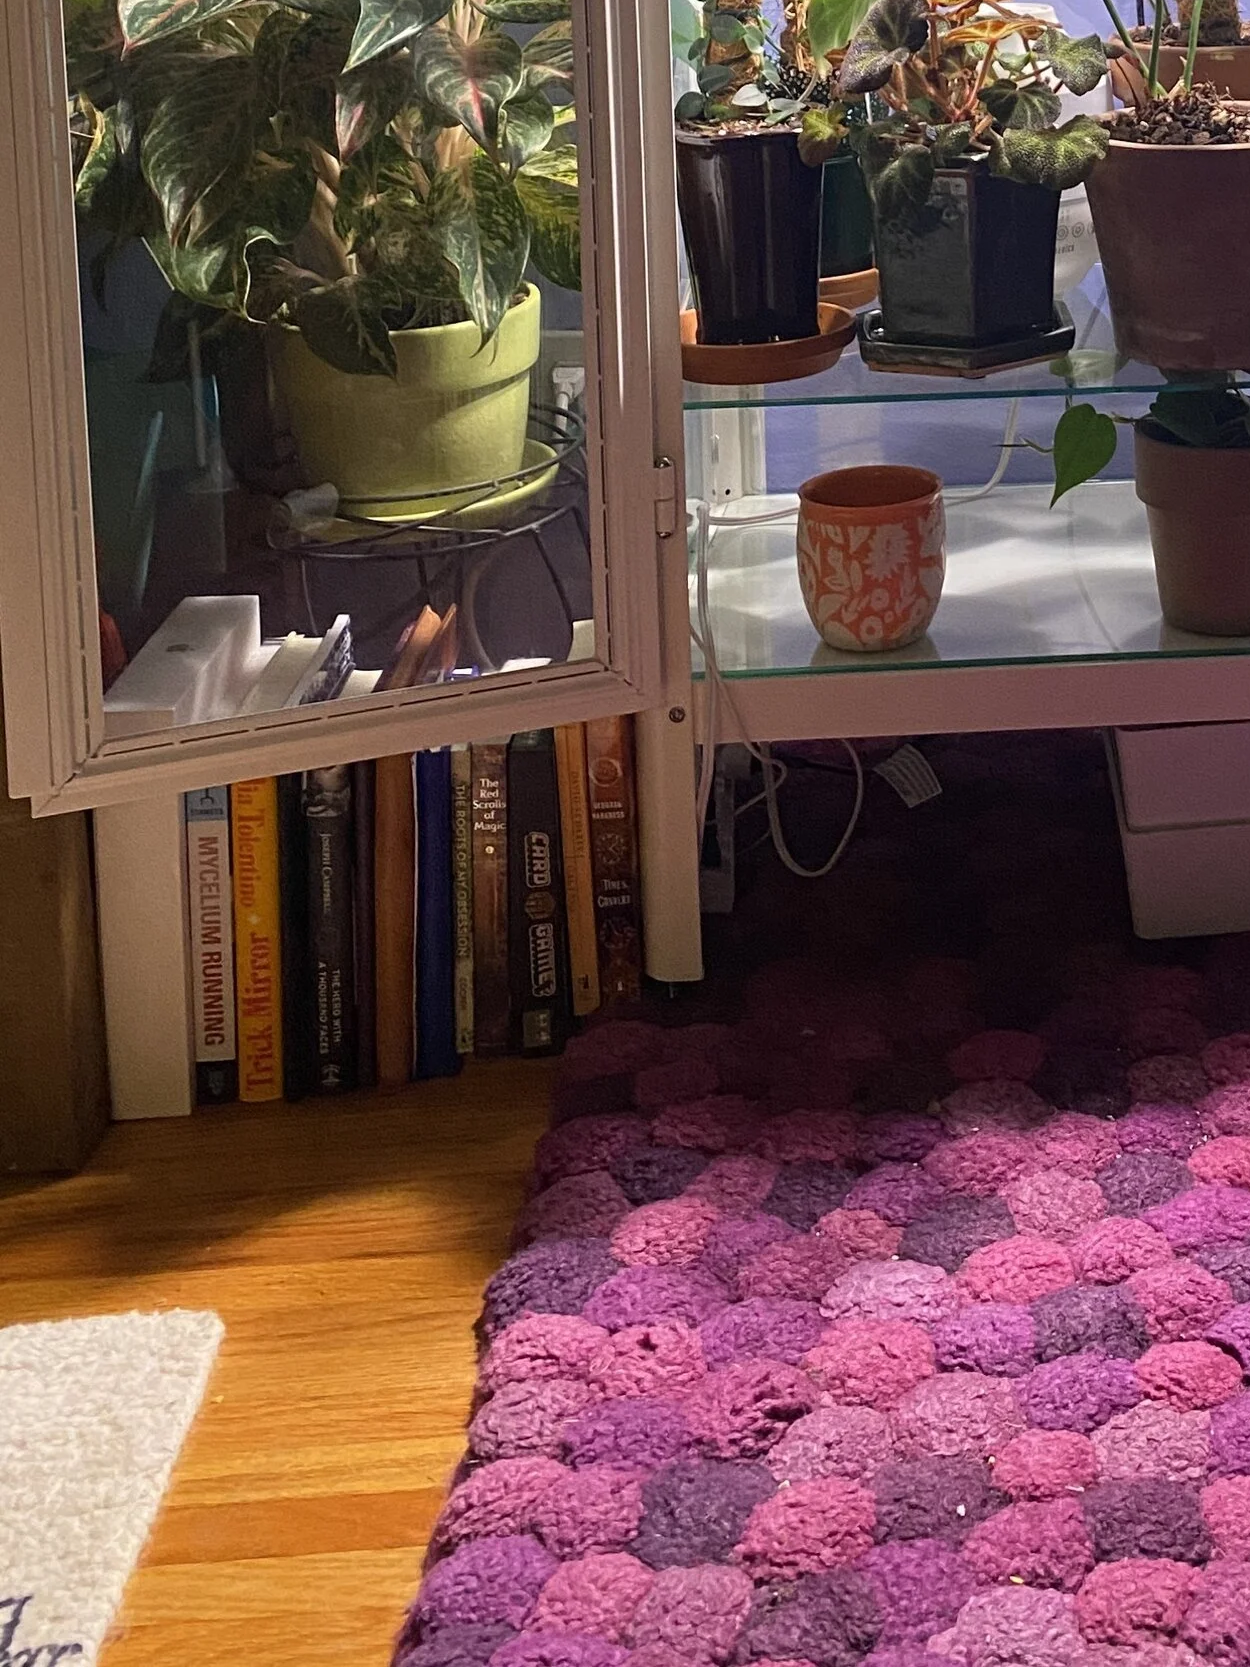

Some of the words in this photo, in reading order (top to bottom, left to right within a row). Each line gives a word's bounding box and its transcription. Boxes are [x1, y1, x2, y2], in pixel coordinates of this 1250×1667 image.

[455, 785, 466, 808] THE
[479, 778, 499, 788] The
[479, 789, 499, 798] Red
[472, 799, 506, 810] Scrolls
[484, 810, 496, 820] of
[455, 810, 467, 848] ROOTS
[474, 821, 506, 833] Magic
[237, 808, 265, 908] Tolentino
[527, 833, 550, 886] CARD
[197, 836, 222, 945] MYCELIUM
[456, 868, 467, 889] MY
[456, 890, 468, 956] OBSESSION
[242, 932, 272, 1018] Mirror
[318, 961, 327, 969] A
[331, 968, 341, 986] THE
[202, 951, 226, 1047] RUNNING
[318, 972, 328, 1023] THOUSAND
[319, 1024, 329, 1055] FACES
[332, 1017, 342, 1043] WITH
[246, 1025, 274, 1092] Trick
